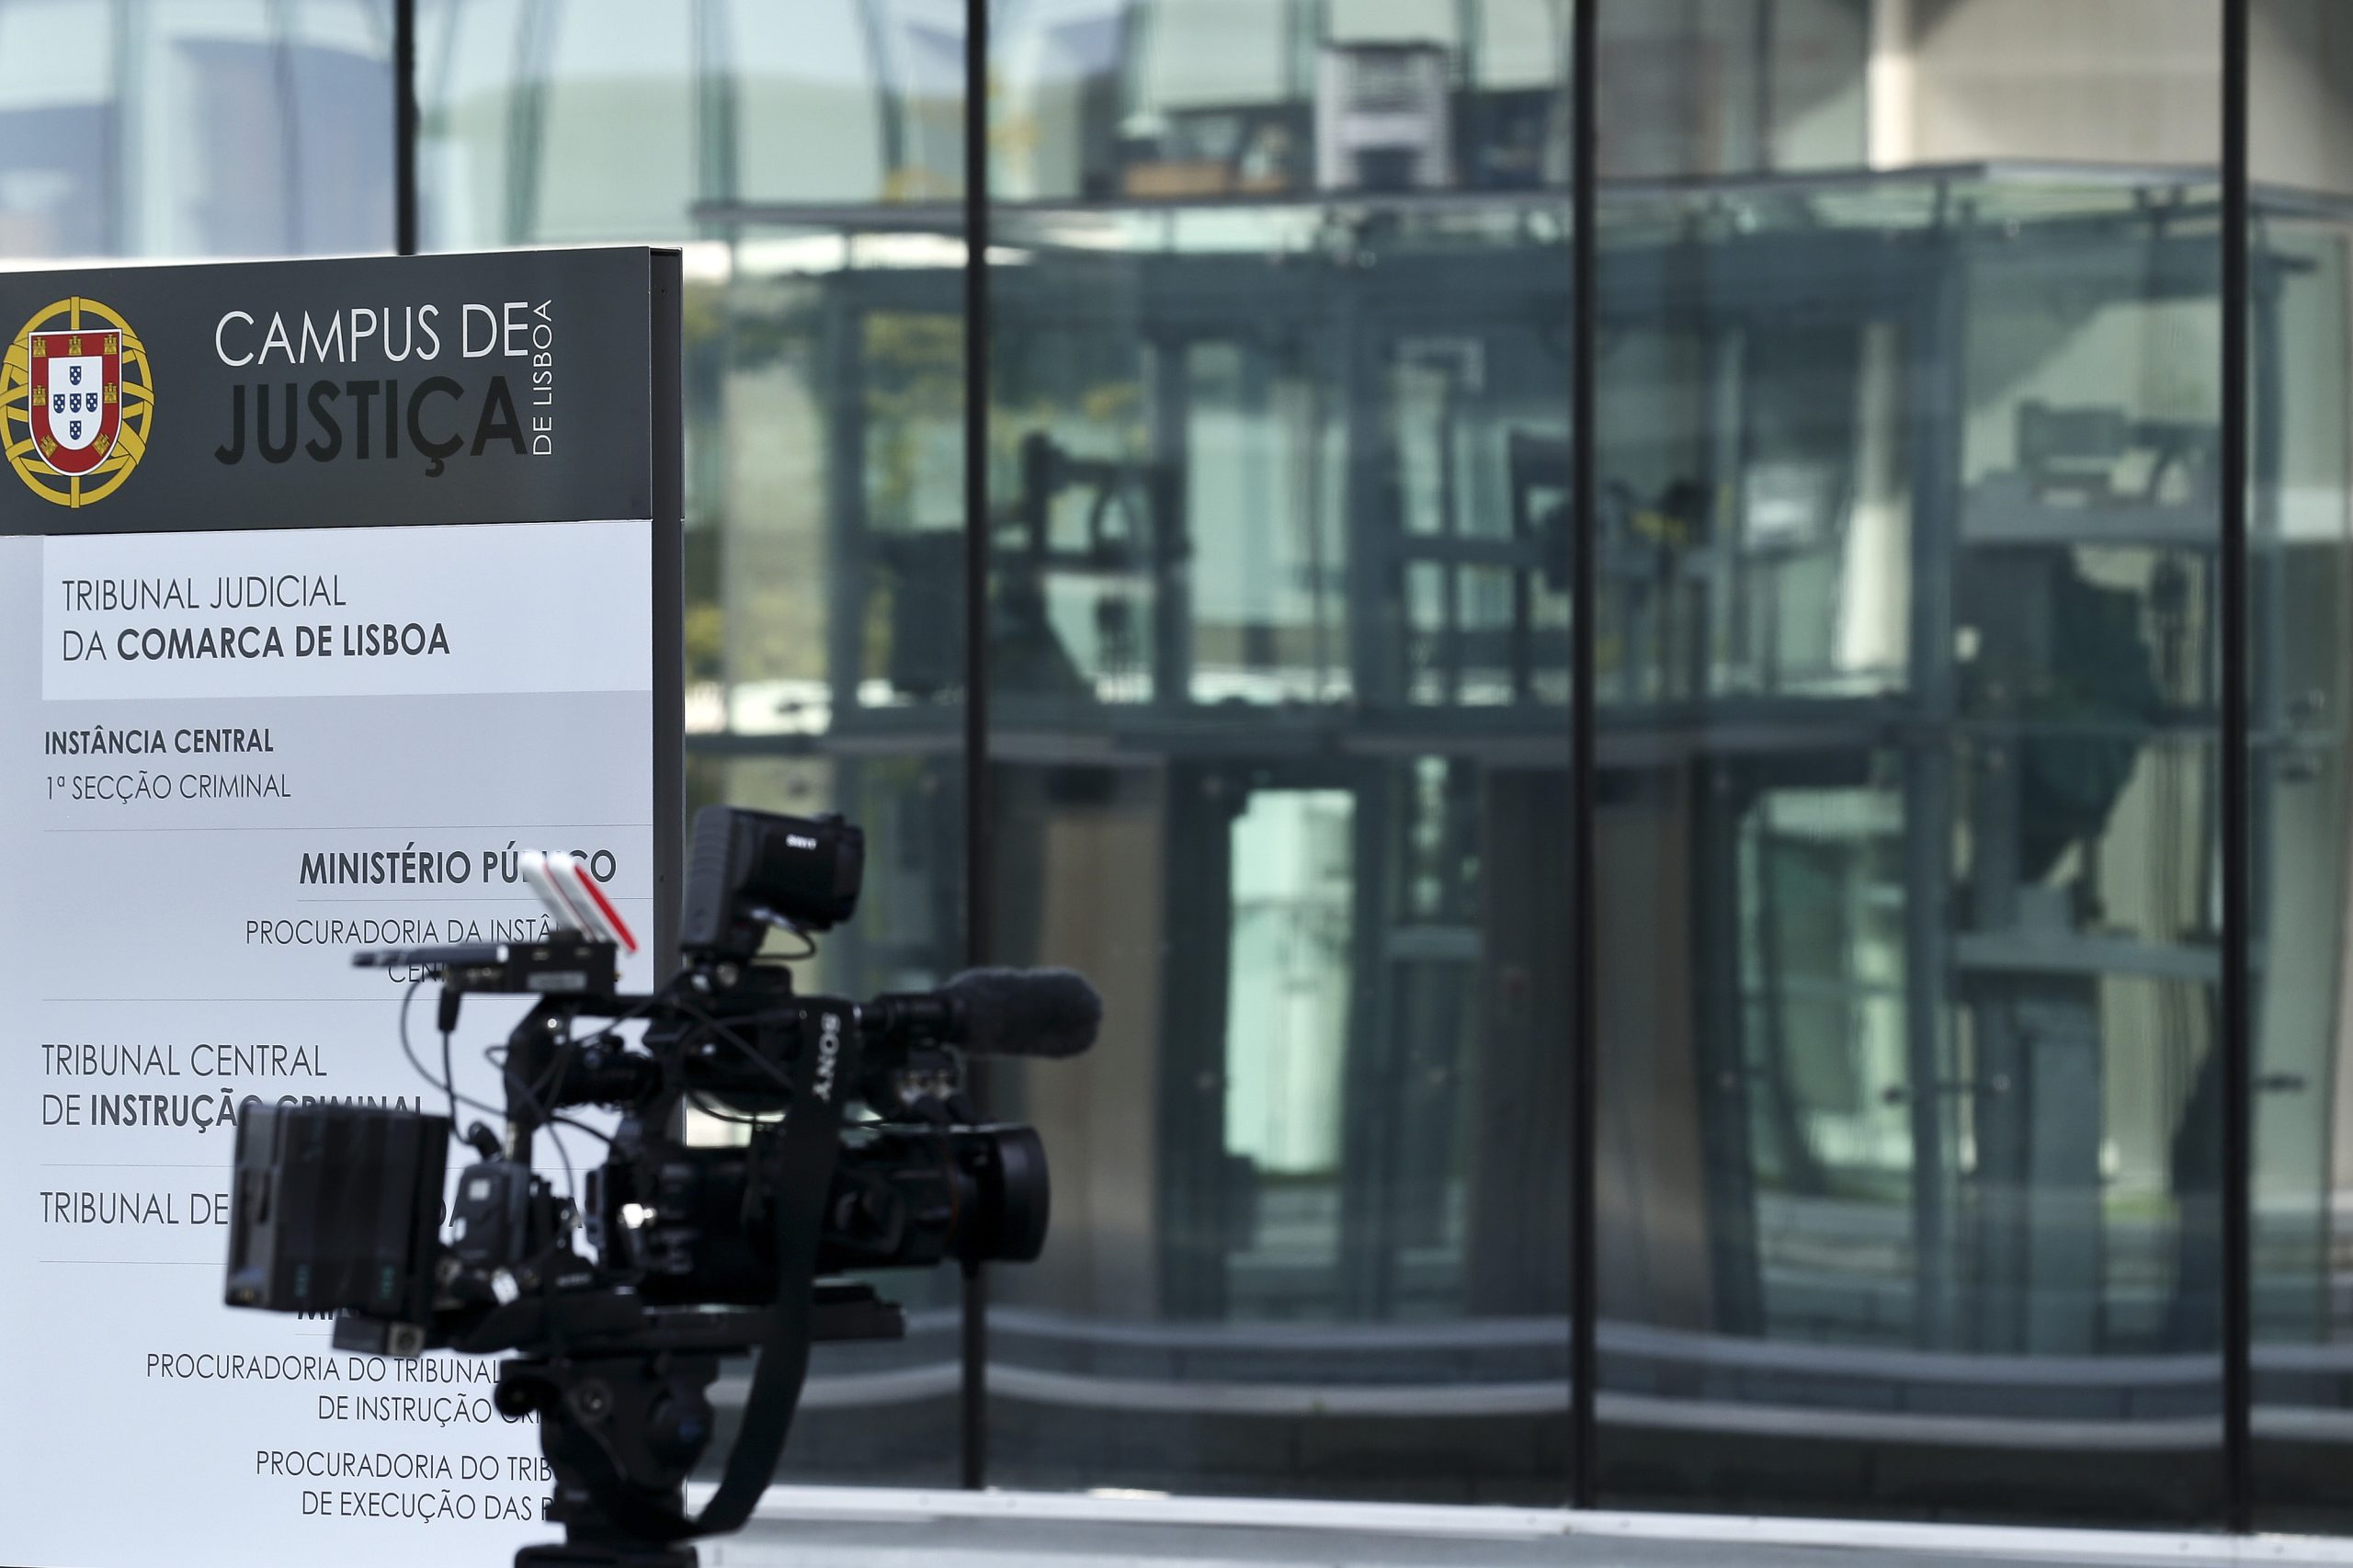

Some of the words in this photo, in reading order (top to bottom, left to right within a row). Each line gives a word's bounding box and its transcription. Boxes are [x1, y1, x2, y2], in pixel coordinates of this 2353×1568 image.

[215, 303, 440, 367] CAMPUS
[462, 301, 529, 358] DE
[532, 299, 552, 405] LISBOA
[213, 375, 529, 478] JUSTIÇA
[532, 416, 552, 456] DE
[63, 577, 200, 612] TRIBUNAL
[210, 574, 347, 609] JUDICIAL
[63, 630, 108, 662] DA
[117, 626, 284, 661] COMARCA
[295, 625, 333, 658] DE
[343, 621, 451, 657] LISBOA
[45, 724, 167, 756] INSTÂNCIA
[174, 728, 274, 754] CENTRAL
[46, 775, 66, 801] 1ª
[72, 769, 172, 805] SECÇÃO
[179, 773, 292, 800] CRIMINAL
[299, 841, 472, 885] MINISTÉRIO
[246, 919, 439, 945] PROCURADORIA
[448, 919, 483, 943] DA
[41, 1044, 181, 1076] TRIBUNAL
[190, 1043, 328, 1077] CENTRAL
[42, 1094, 82, 1126] DE
[91, 1086, 263, 1134] INSTRUÇÃ
[40, 1191, 180, 1225] TRIBUNAL
[190, 1193, 229, 1225] DE
[147, 1353, 341, 1381] PROCURADORIA
[348, 1356, 387, 1382] DO
[394, 1358, 499, 1384] TRIBUNAL
[318, 1394, 349, 1420] DE
[356, 1392, 493, 1428] INSTRUÇÃO
[256, 1450, 453, 1480] PROCURADORIA
[461, 1455, 500, 1481] DO
[302, 1490, 333, 1516] DE
[340, 1488, 476, 1524] EXECUÇÃO
[484, 1494, 532, 1521] DAS
